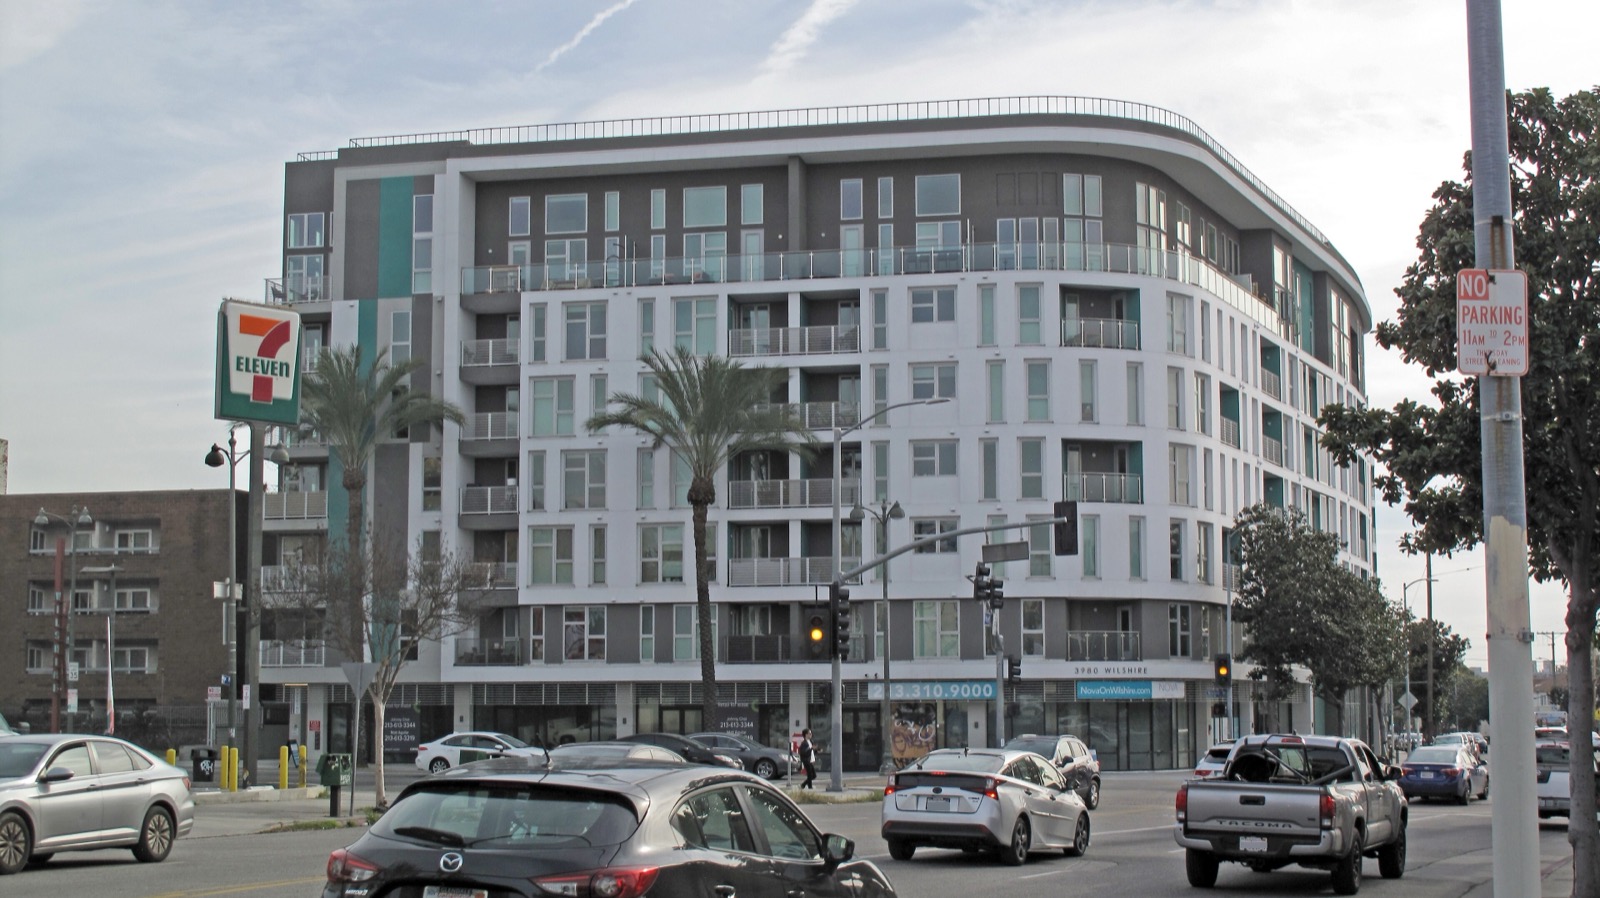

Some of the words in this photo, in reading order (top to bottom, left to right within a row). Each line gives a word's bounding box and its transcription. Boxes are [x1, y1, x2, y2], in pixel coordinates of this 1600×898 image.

[1460, 274, 1487, 297] NO
[1462, 305, 1523, 325] PARKING
[1463, 329, 1485, 345] 11AM
[1503, 330, 1525, 346] 2PM
[1074, 666, 1099, 675] 3980
[1104, 666, 1148, 675] WILSHIRE
[873, 684, 993, 698] 23.310.9000
[1080, 685, 1151, 696] NovaOnWilshire.com
[1216, 819, 1293, 829] TACOMA
